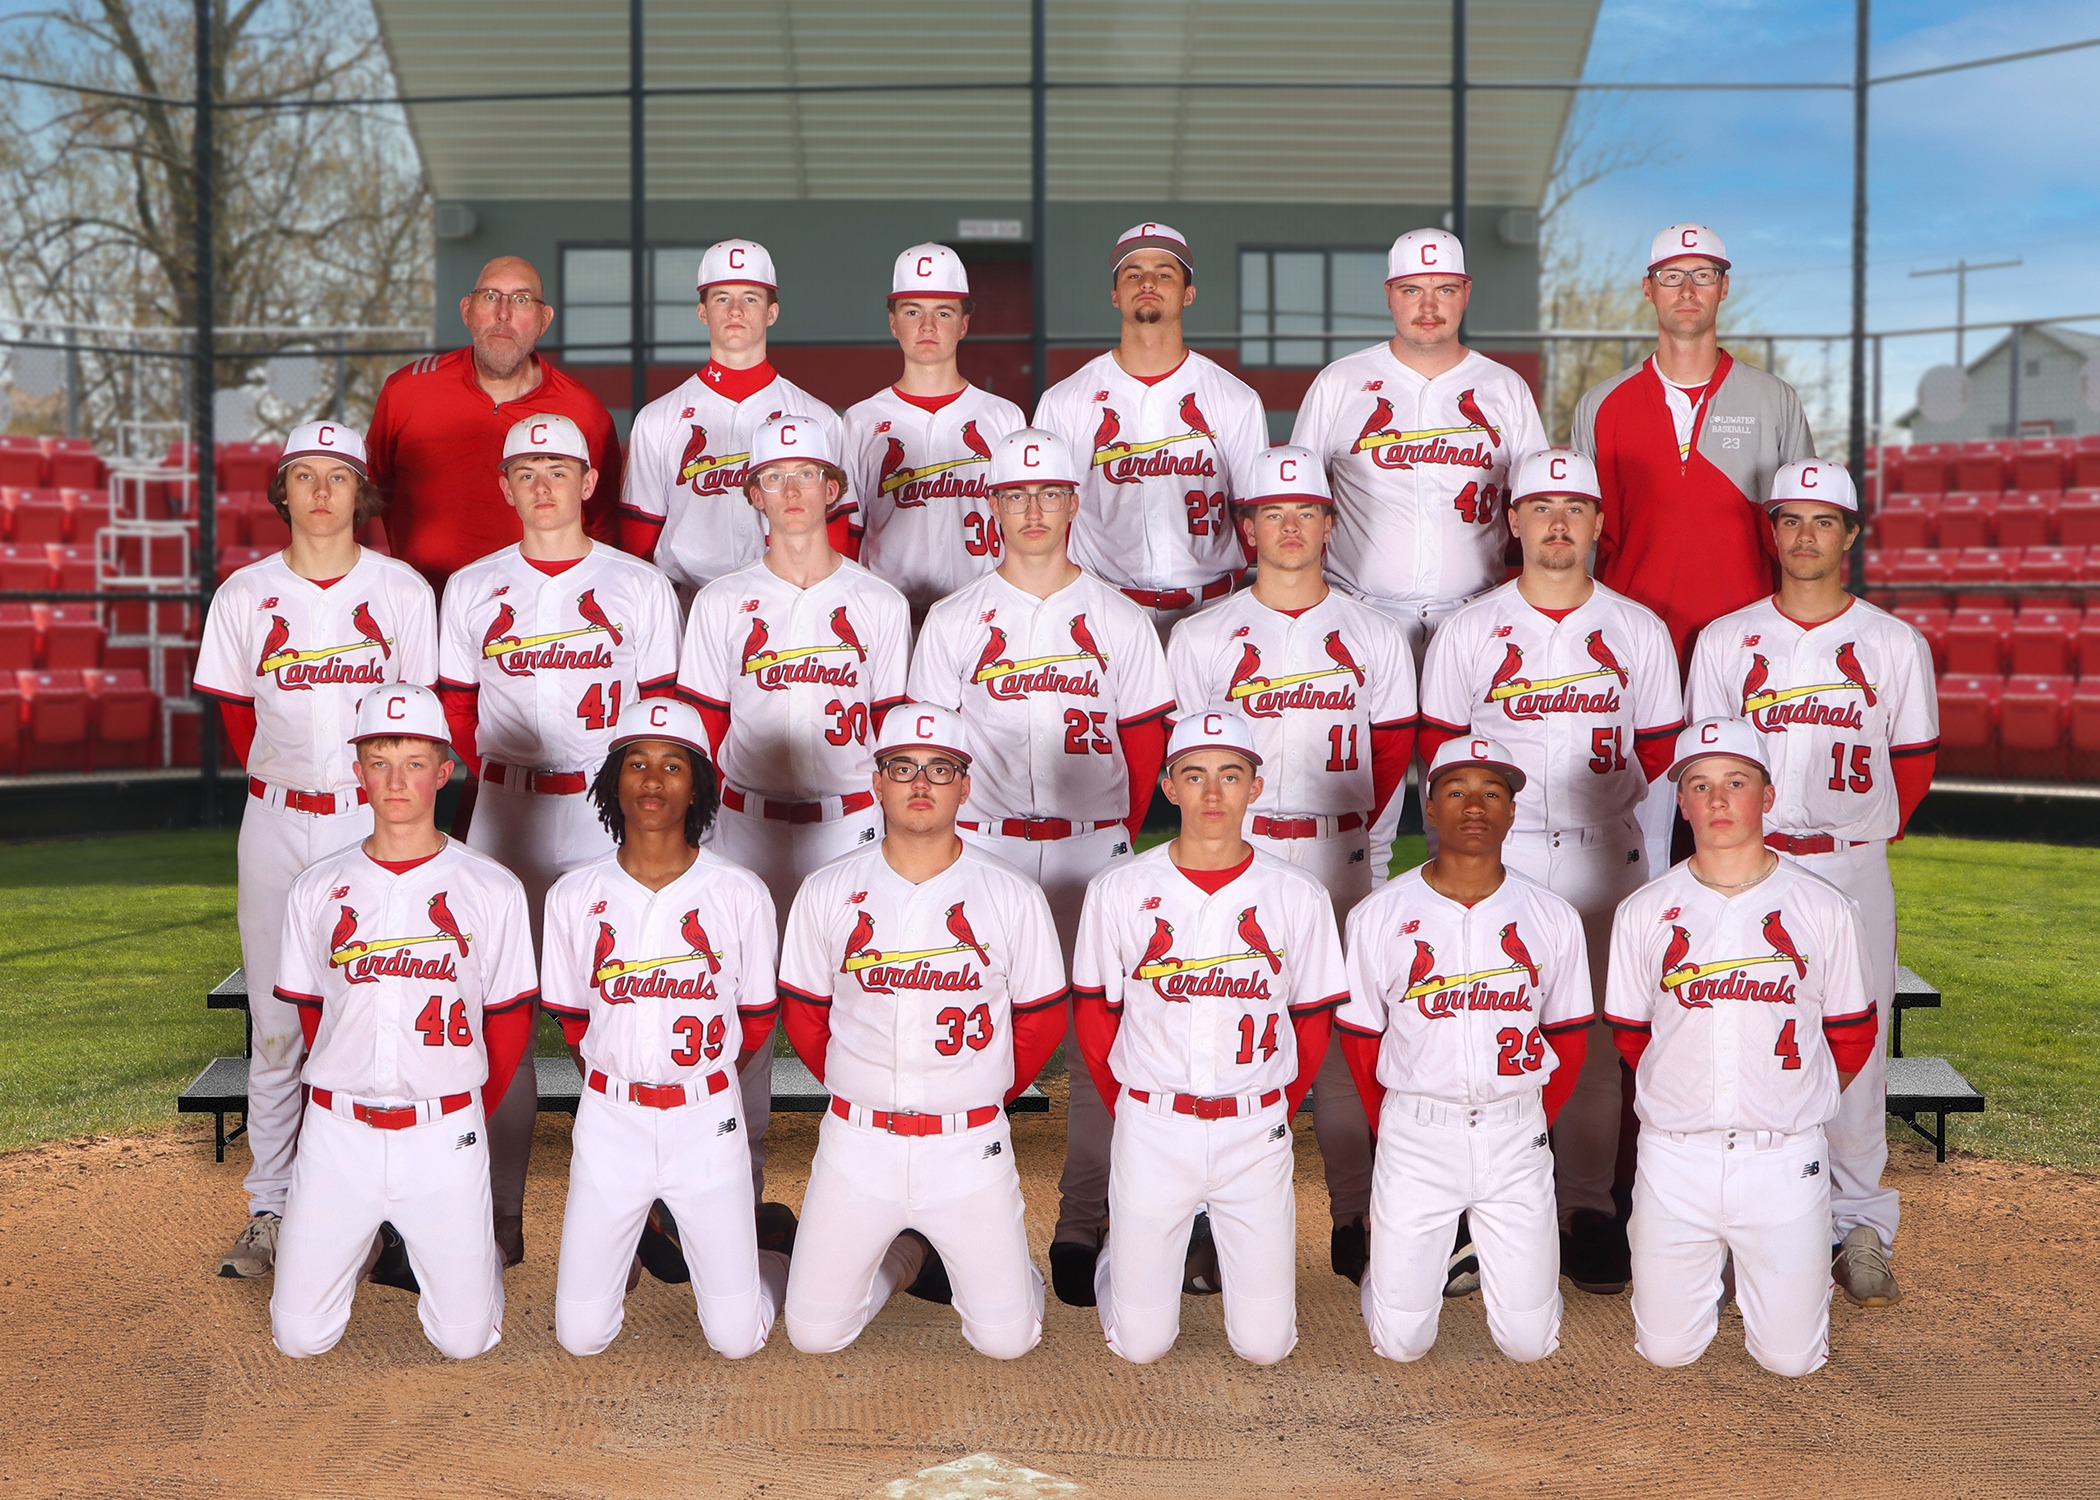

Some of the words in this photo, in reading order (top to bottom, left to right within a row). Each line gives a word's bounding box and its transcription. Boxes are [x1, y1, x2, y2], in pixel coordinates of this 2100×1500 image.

[1141, 224, 1156, 237] C
[1681, 230, 1697, 247] C
[729, 249, 745, 268] C
[916, 257, 932, 277] C
[1421, 244, 1437, 265] C
[318, 427, 334, 446] C
[531, 424, 547, 444] C
[780, 425, 796, 444] C
[1371, 429, 1494, 470] Cardinals
[1712, 425, 1751, 434] BASEBALL
[1722, 437, 1740, 449] 23
[1024, 445, 1039, 467] C
[1104, 442, 1216, 484] Cardinals
[1280, 460, 1296, 481] C
[1550, 458, 1566, 479] C
[1801, 467, 1818, 488] C
[1185, 490, 1225, 535] 23
[1454, 481, 1498, 524] 40
[964, 511, 1000, 556] 36
[274, 648, 385, 691] Cardinals
[498, 636, 613, 677] Cardinals
[757, 651, 858, 690] Cardinals
[987, 659, 1099, 701] Cardinals
[1243, 676, 1356, 718] Cardinals
[1503, 678, 1620, 721] Cardinals
[387, 697, 405, 719] C
[577, 680, 621, 730] 41
[650, 706, 667, 726] C
[824, 699, 867, 746] 30
[1204, 714, 1222, 734] C
[1752, 689, 1863, 733] Cardinals
[916, 716, 934, 738] C
[1064, 708, 1112, 754] 25
[1701, 724, 1718, 743] C
[1326, 725, 1359, 772] 11
[1471, 741, 1488, 759] C
[1589, 726, 1627, 774] 51
[1829, 742, 1872, 793] 15
[345, 941, 458, 984] Cardinals
[600, 959, 719, 1005] Cardinals
[855, 949, 983, 996] Cardinals
[1154, 957, 1271, 1003] Cardinals
[1418, 975, 1532, 1020] Cardinals
[1673, 963, 1796, 1008] Cardinals
[671, 1015, 726, 1066] 39
[935, 1003, 993, 1056] 33
[1236, 1013, 1278, 1064] 14
[1775, 1019, 1801, 1069] 4
[1497, 1026, 1545, 1076] 29
